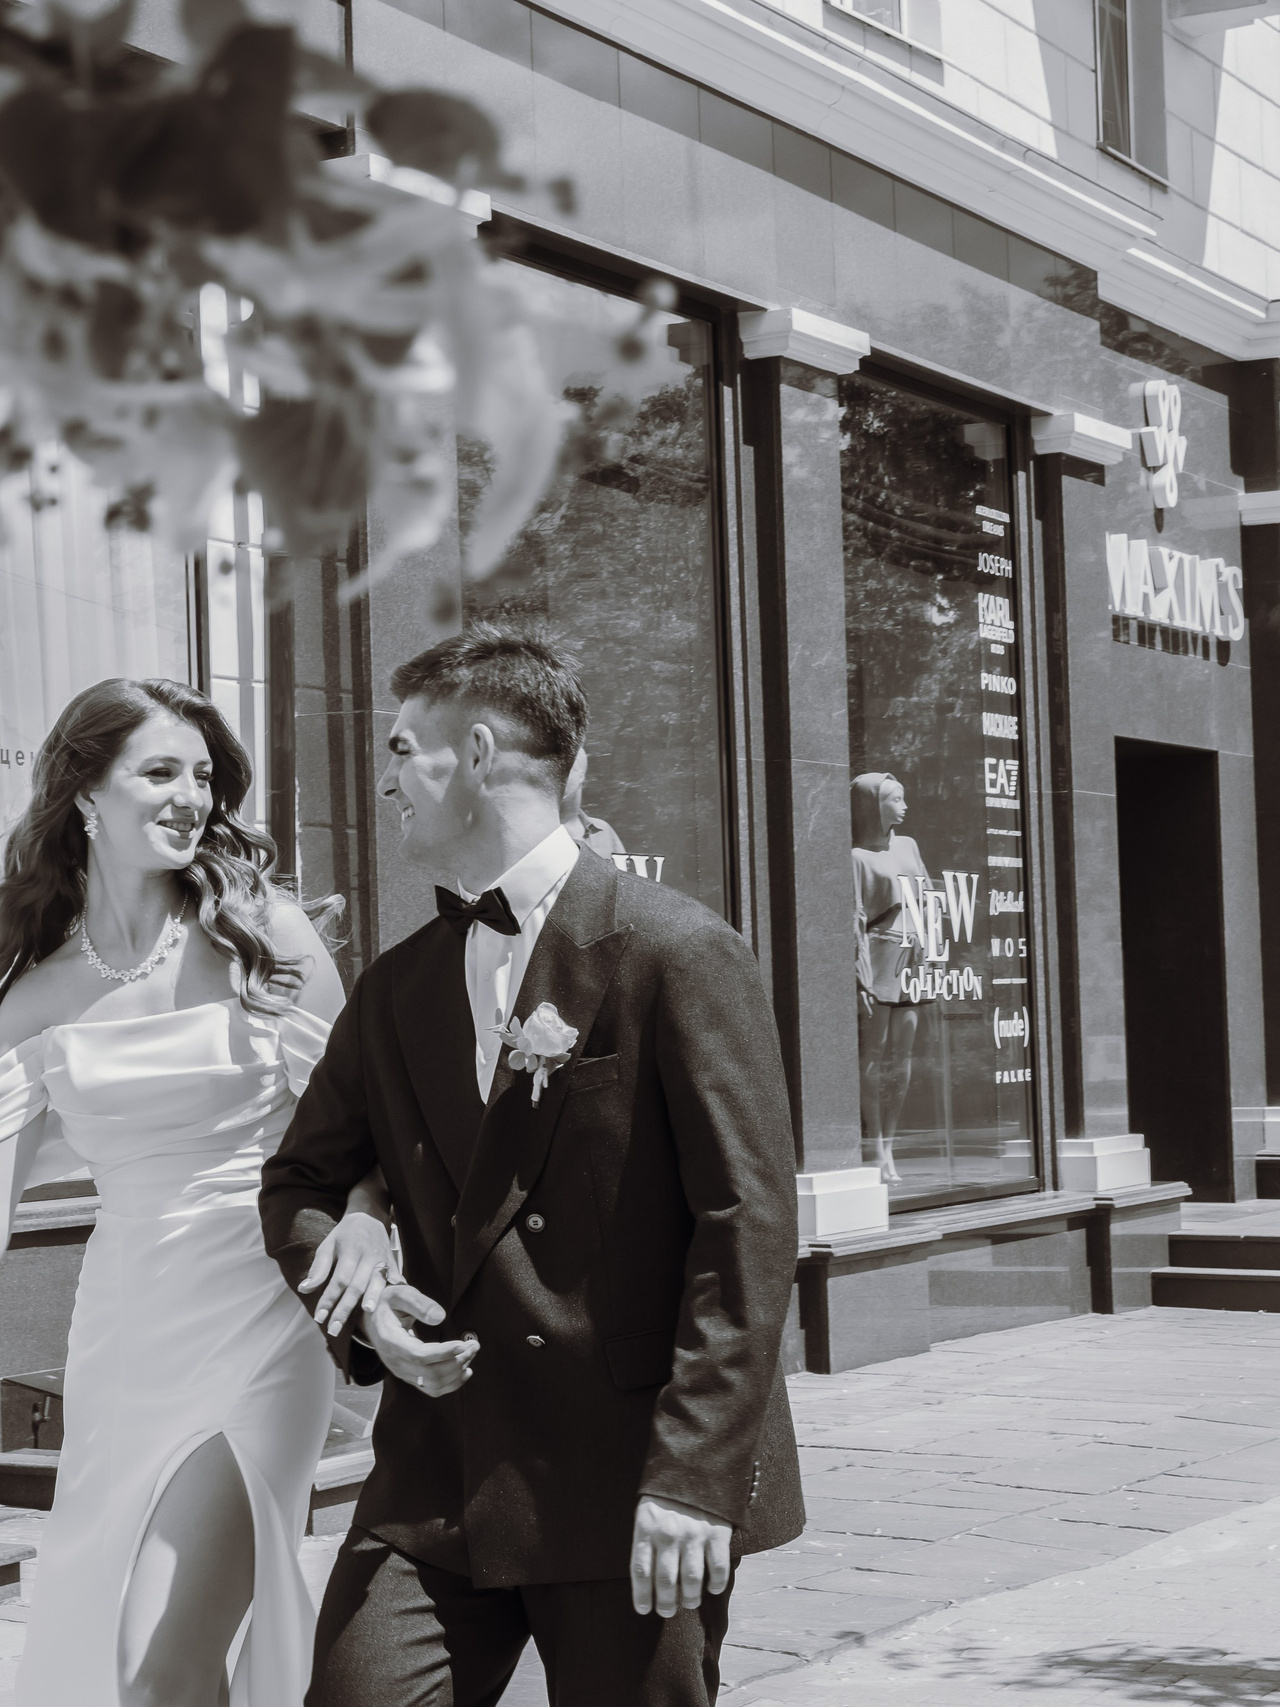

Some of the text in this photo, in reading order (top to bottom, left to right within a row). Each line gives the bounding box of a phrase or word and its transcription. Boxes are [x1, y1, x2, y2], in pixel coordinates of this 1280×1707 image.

[977, 552, 1013, 579] JOSEPH
[978, 592, 1015, 629] KARL
[980, 672, 1017, 696] PINKO
[896, 870, 980, 963] NEW
[900, 965, 984, 1004] COLLECTION
[995, 1068, 1032, 1084] FALKE
